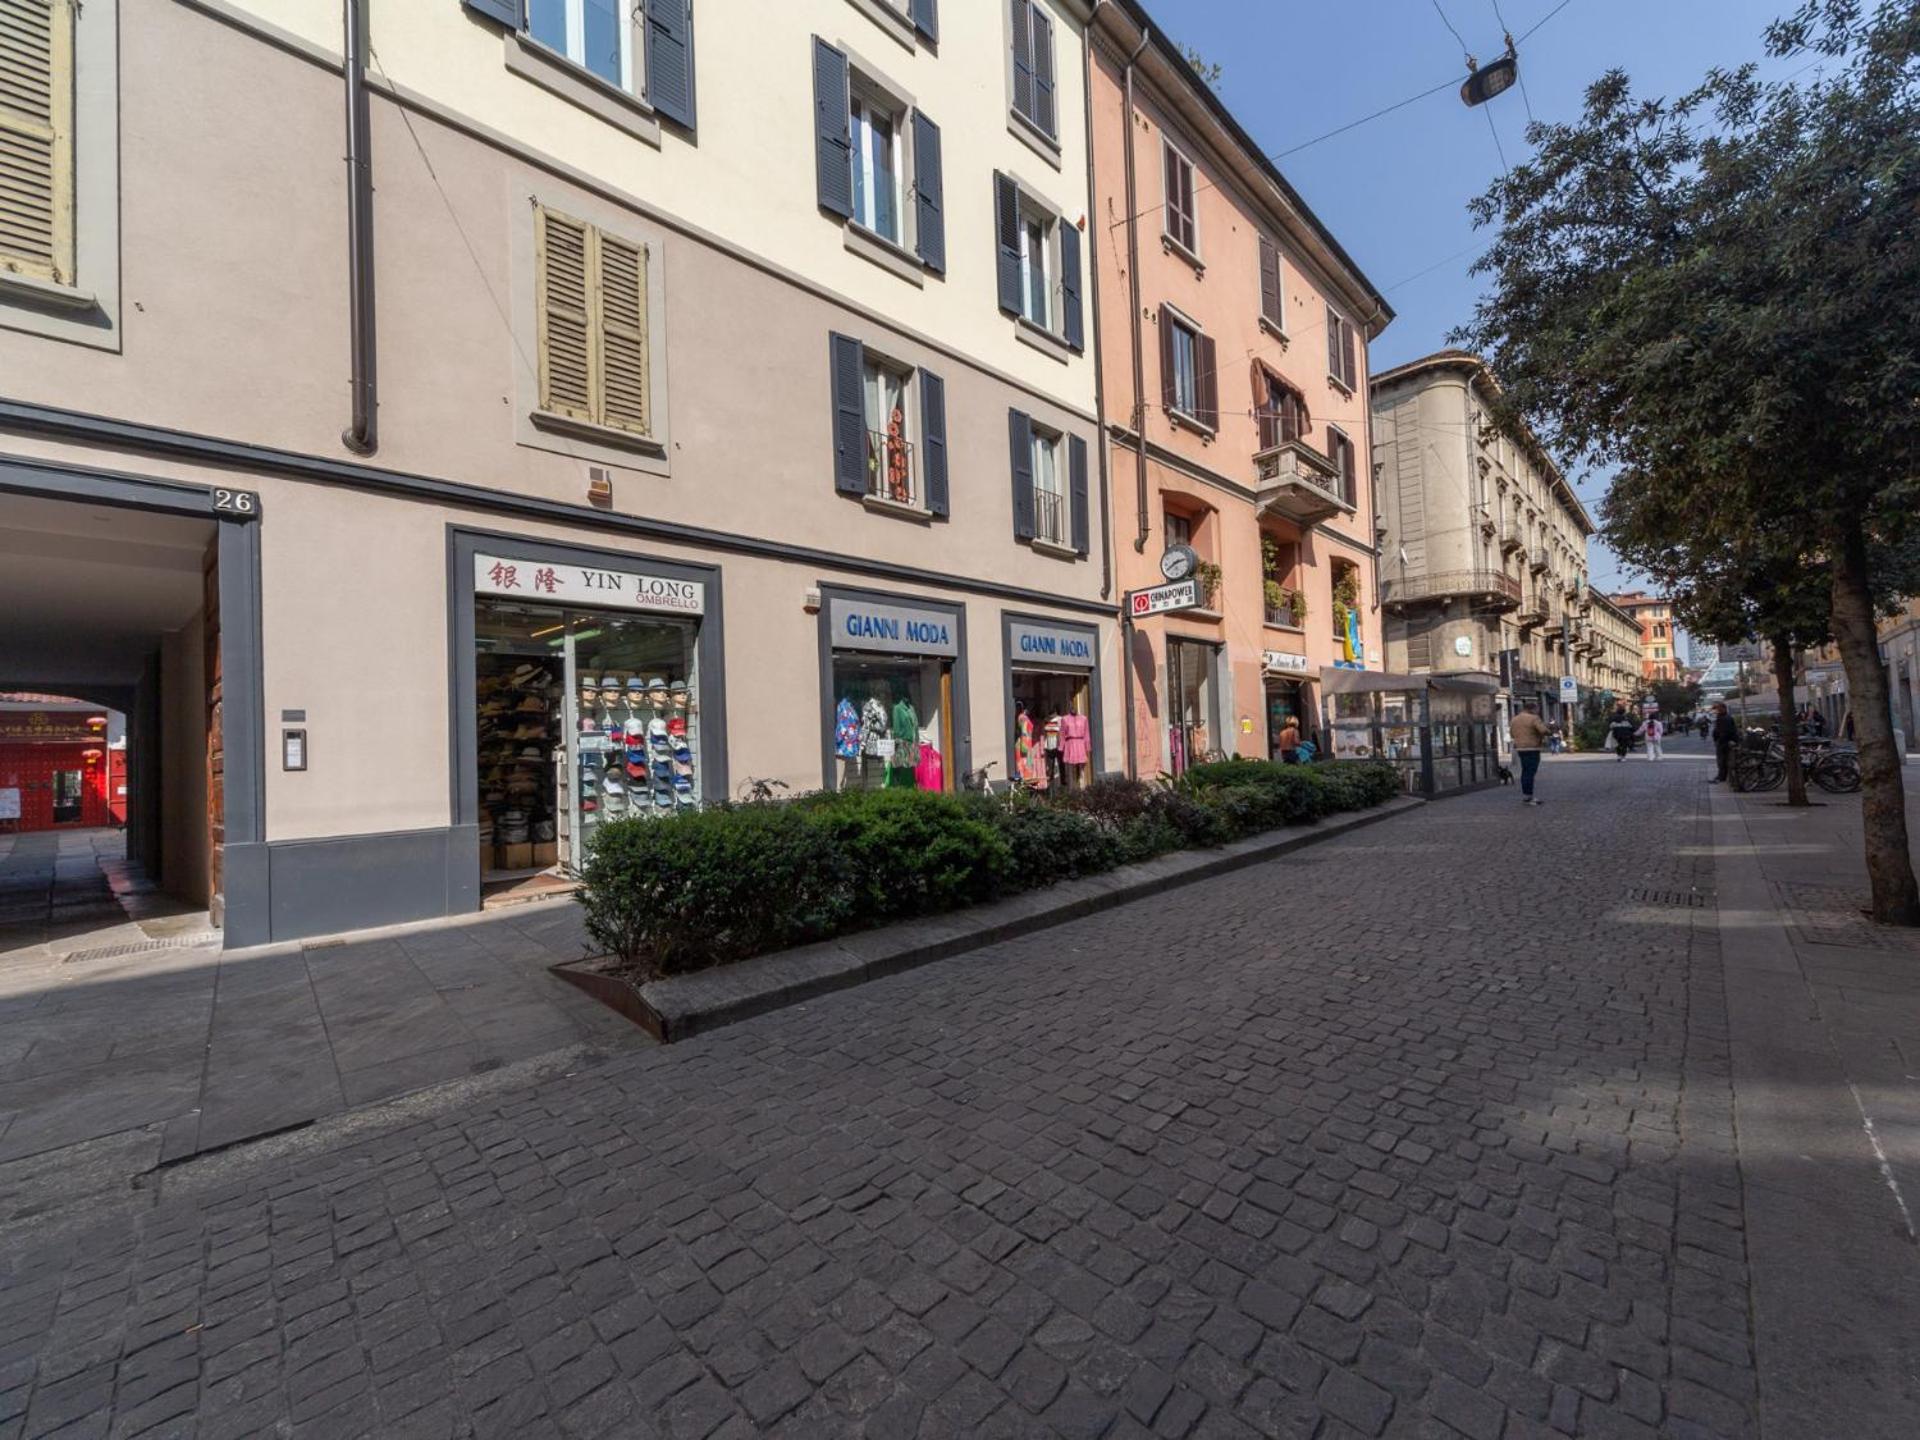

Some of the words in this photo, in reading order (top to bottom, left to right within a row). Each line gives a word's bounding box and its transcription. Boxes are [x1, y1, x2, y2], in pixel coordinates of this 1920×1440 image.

[216, 490, 251, 511] 26
[581, 570, 622, 590] YIN
[638, 578, 695, 599] LONG
[636, 593, 699, 609] OMBRELLO
[847, 614, 898, 641] GIANNI
[906, 620, 949, 645] MODA
[1020, 634, 1055, 655] GIANNI
[1060, 642, 1089, 658] MODA
